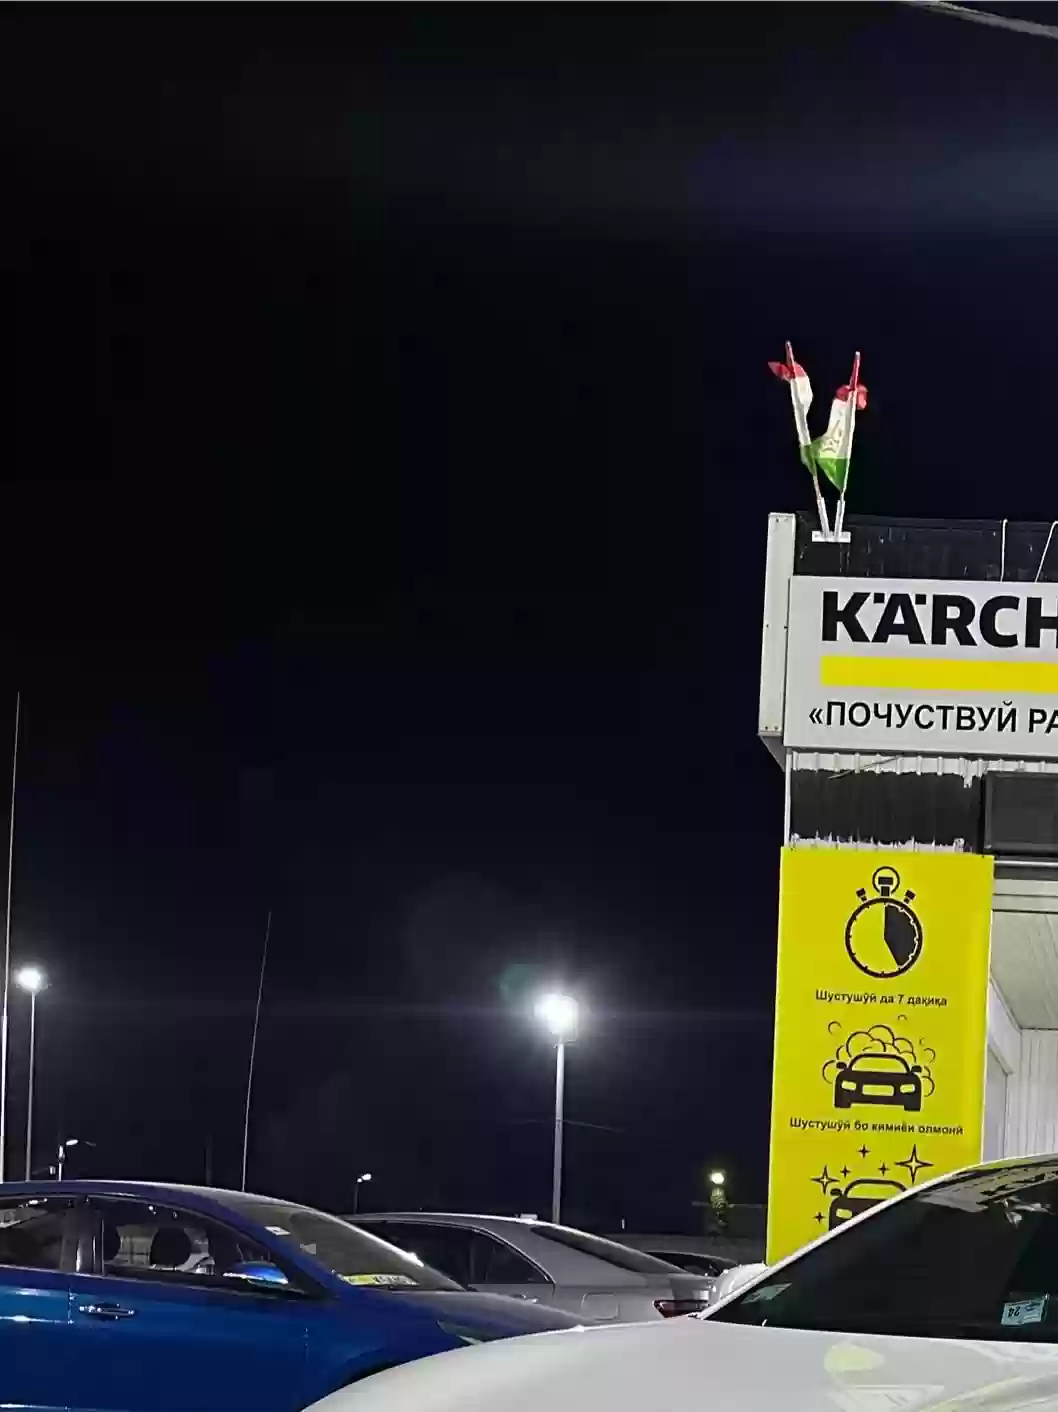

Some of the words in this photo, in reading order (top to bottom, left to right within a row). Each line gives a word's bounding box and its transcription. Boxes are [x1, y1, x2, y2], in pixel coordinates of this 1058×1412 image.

[808, 700, 1018, 733] «ПОЧУСТВУЙ
[879, 995, 895, 1005] да
[897, 994, 905, 1005] 7
[854, 1120, 869, 1131] бо
